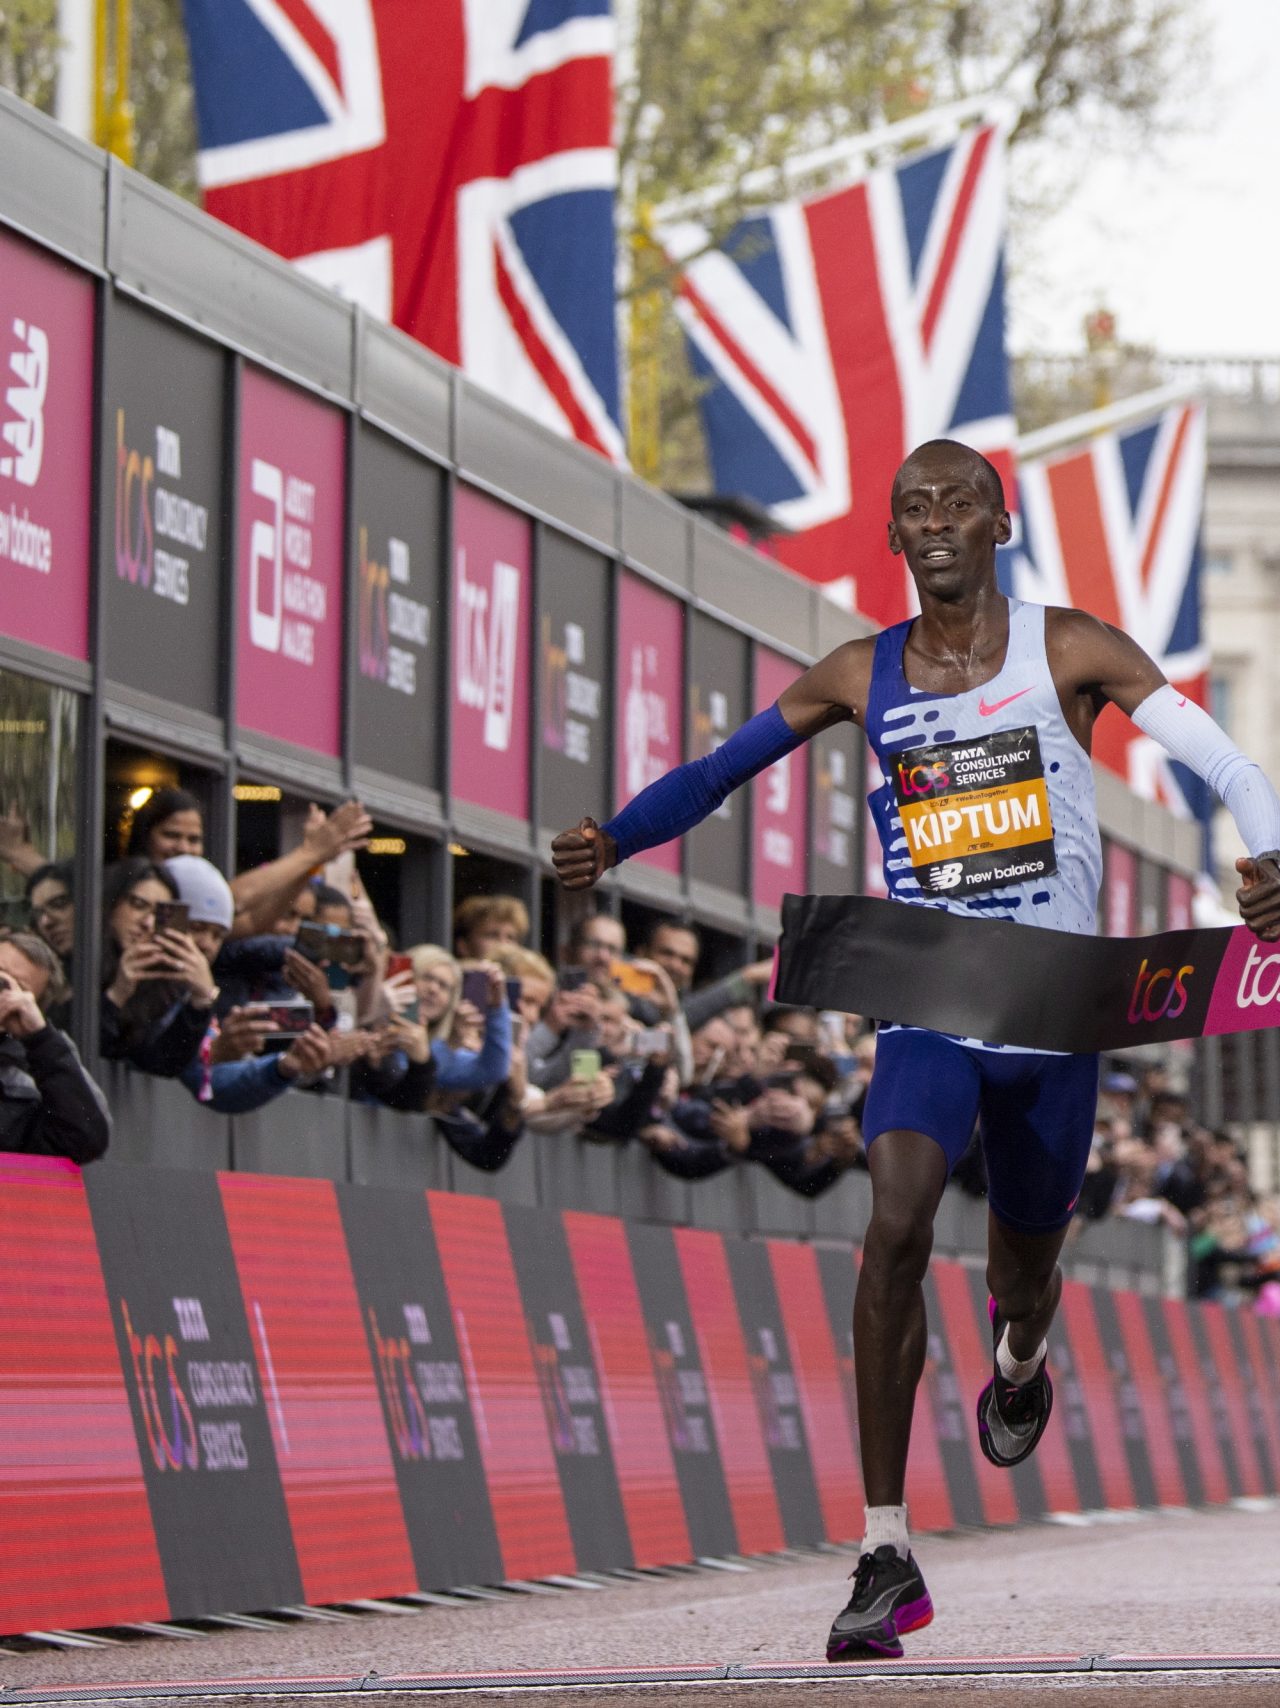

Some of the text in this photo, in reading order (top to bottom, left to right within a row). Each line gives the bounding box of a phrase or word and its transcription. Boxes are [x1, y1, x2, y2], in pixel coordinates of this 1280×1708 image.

[952, 748, 985, 760] TATA
[953, 750, 1031, 773] CONSULTANCY
[898, 761, 950, 796] tcs
[956, 768, 1006, 786] SERVICES
[910, 794, 1041, 849] KIPTUM
[966, 871, 992, 885] new
[994, 861, 1045, 879] balance
[1127, 958, 1195, 1025] tcs
